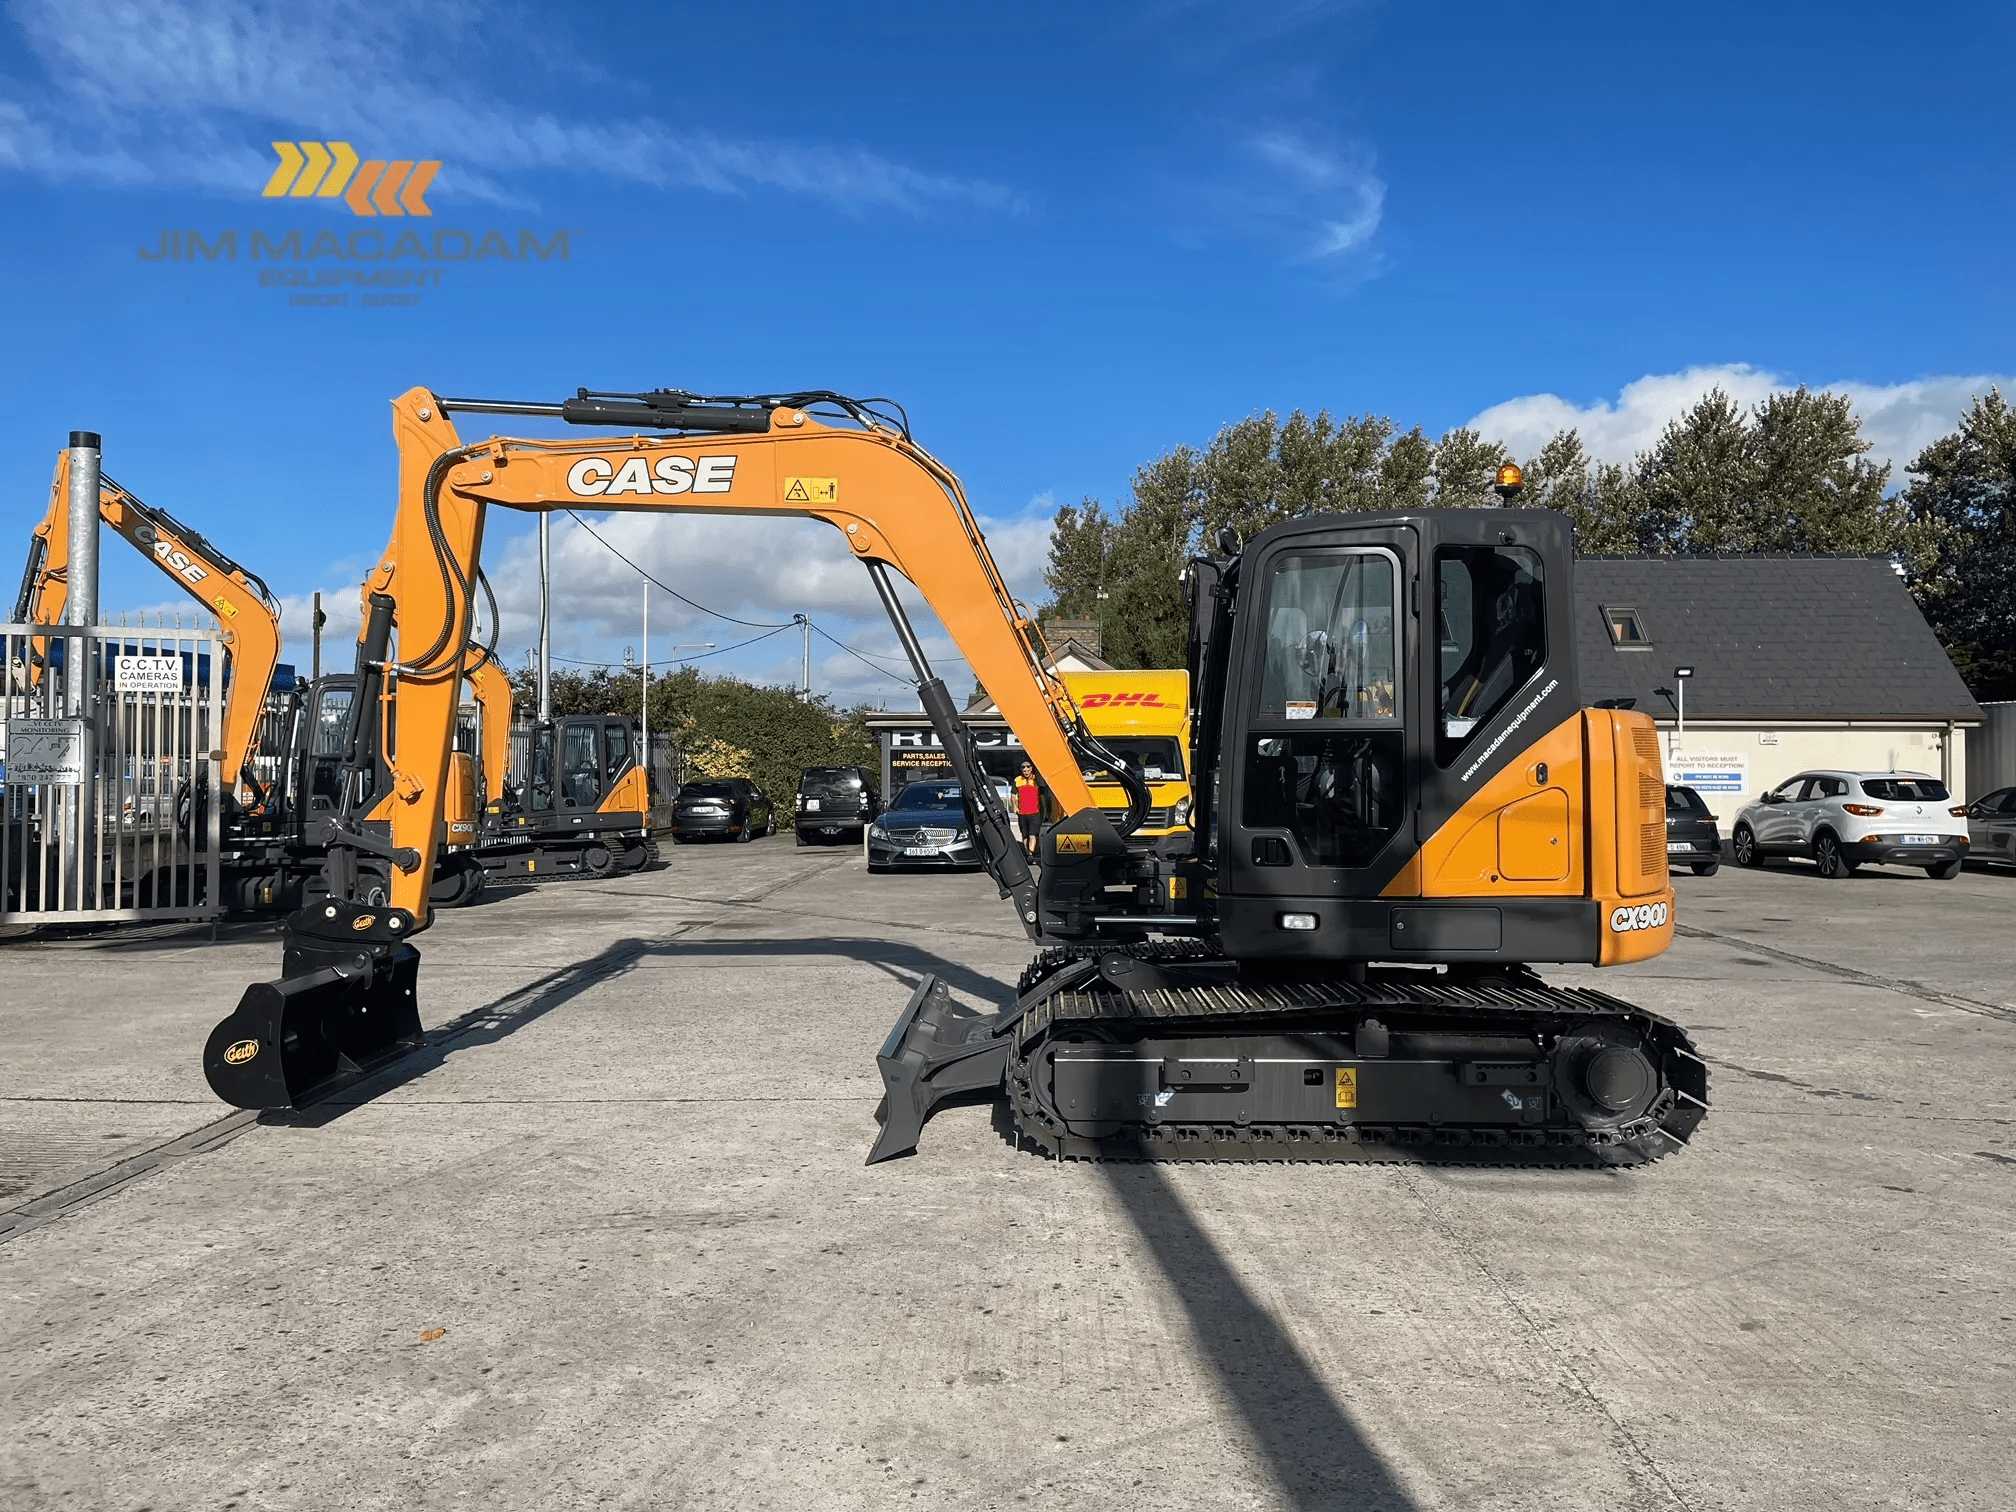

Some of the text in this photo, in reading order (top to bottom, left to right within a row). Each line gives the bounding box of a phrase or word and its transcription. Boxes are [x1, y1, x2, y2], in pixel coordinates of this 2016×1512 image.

[566, 455, 738, 497] CASE
[133, 525, 209, 584] CASE
[119, 671, 178, 681] CAMERAS
[120, 658, 178, 671] C.C.T.V.
[1080, 693, 1166, 708] DHL
[1460, 679, 1559, 782] www.macadamequipment.com
[1609, 901, 1668, 933] CX90D
